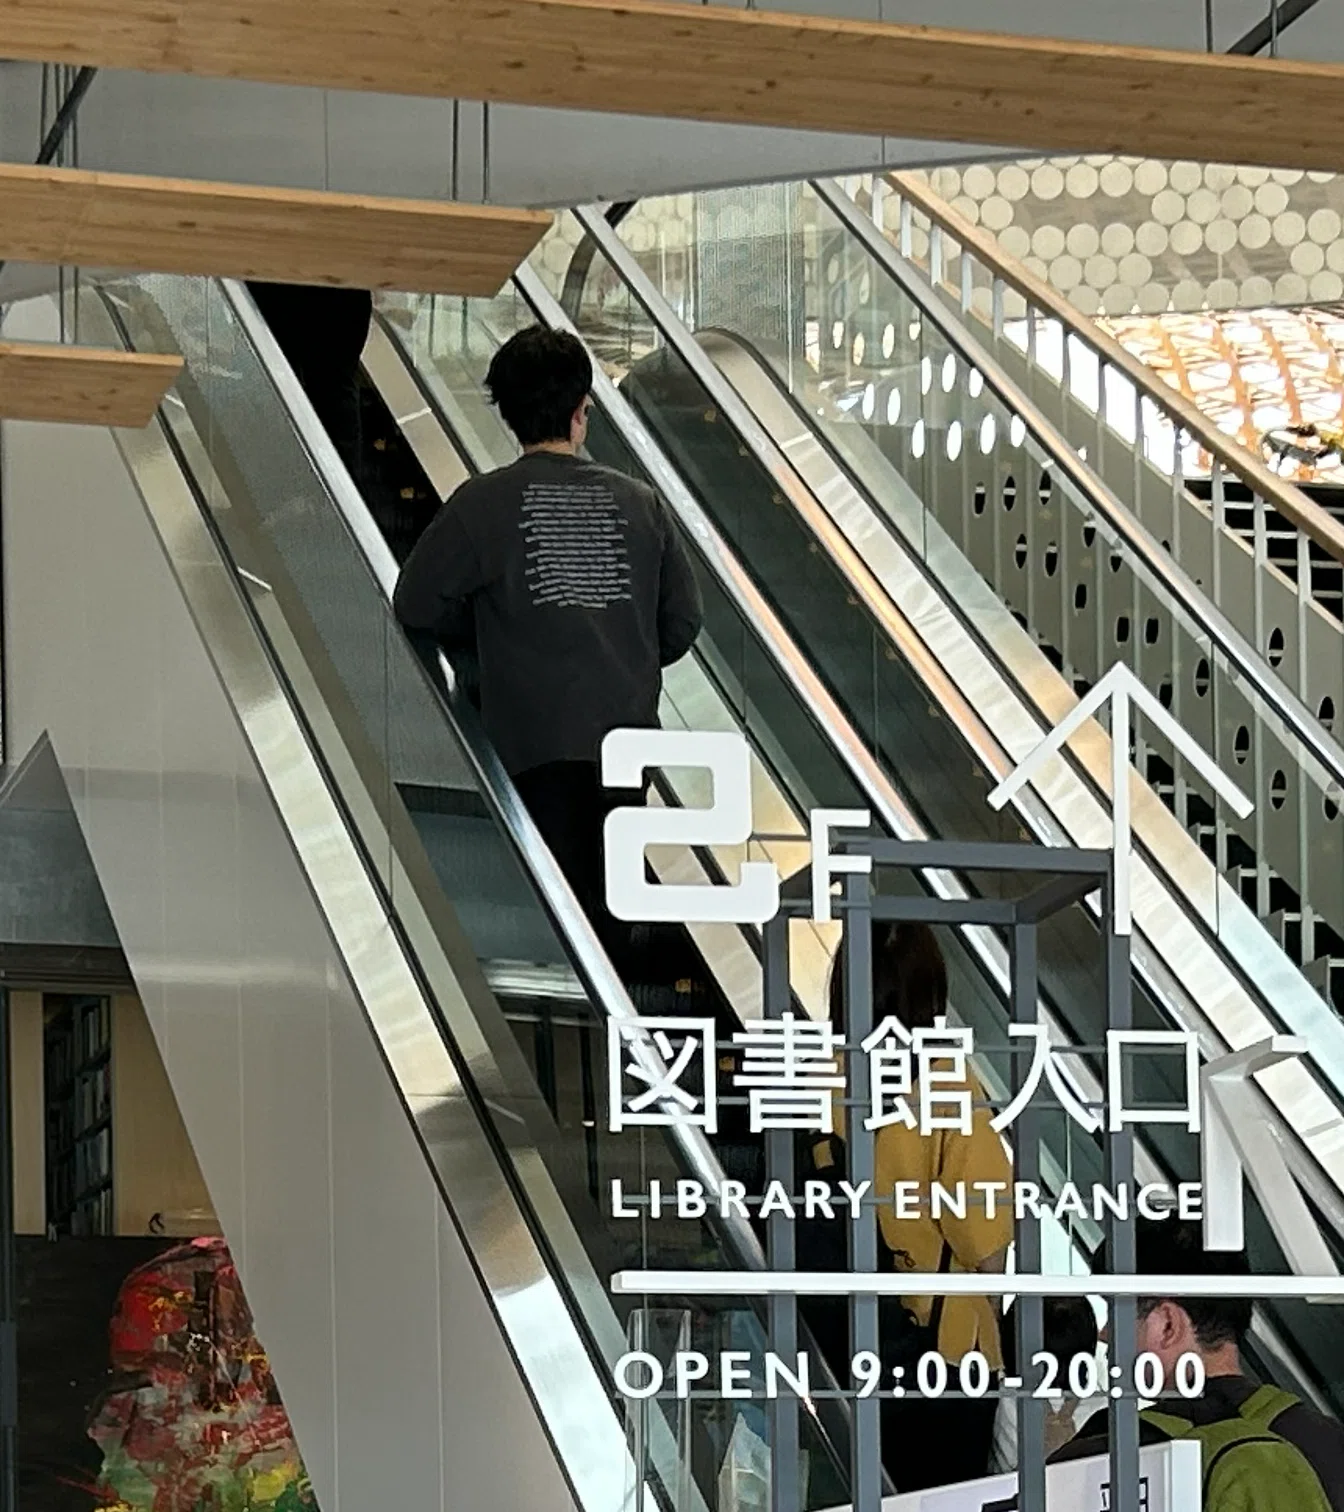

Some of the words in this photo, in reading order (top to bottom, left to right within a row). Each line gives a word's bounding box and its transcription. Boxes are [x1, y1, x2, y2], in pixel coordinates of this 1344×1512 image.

[607, 1011, 1203, 1137] 図書館入口
[611, 1178, 872, 1221] LIBRARY
[894, 1179, 1205, 1223] ENTRANCE
[613, 1350, 812, 1401] OPEN
[851, 1349, 1208, 1401] 9:00-20:00
